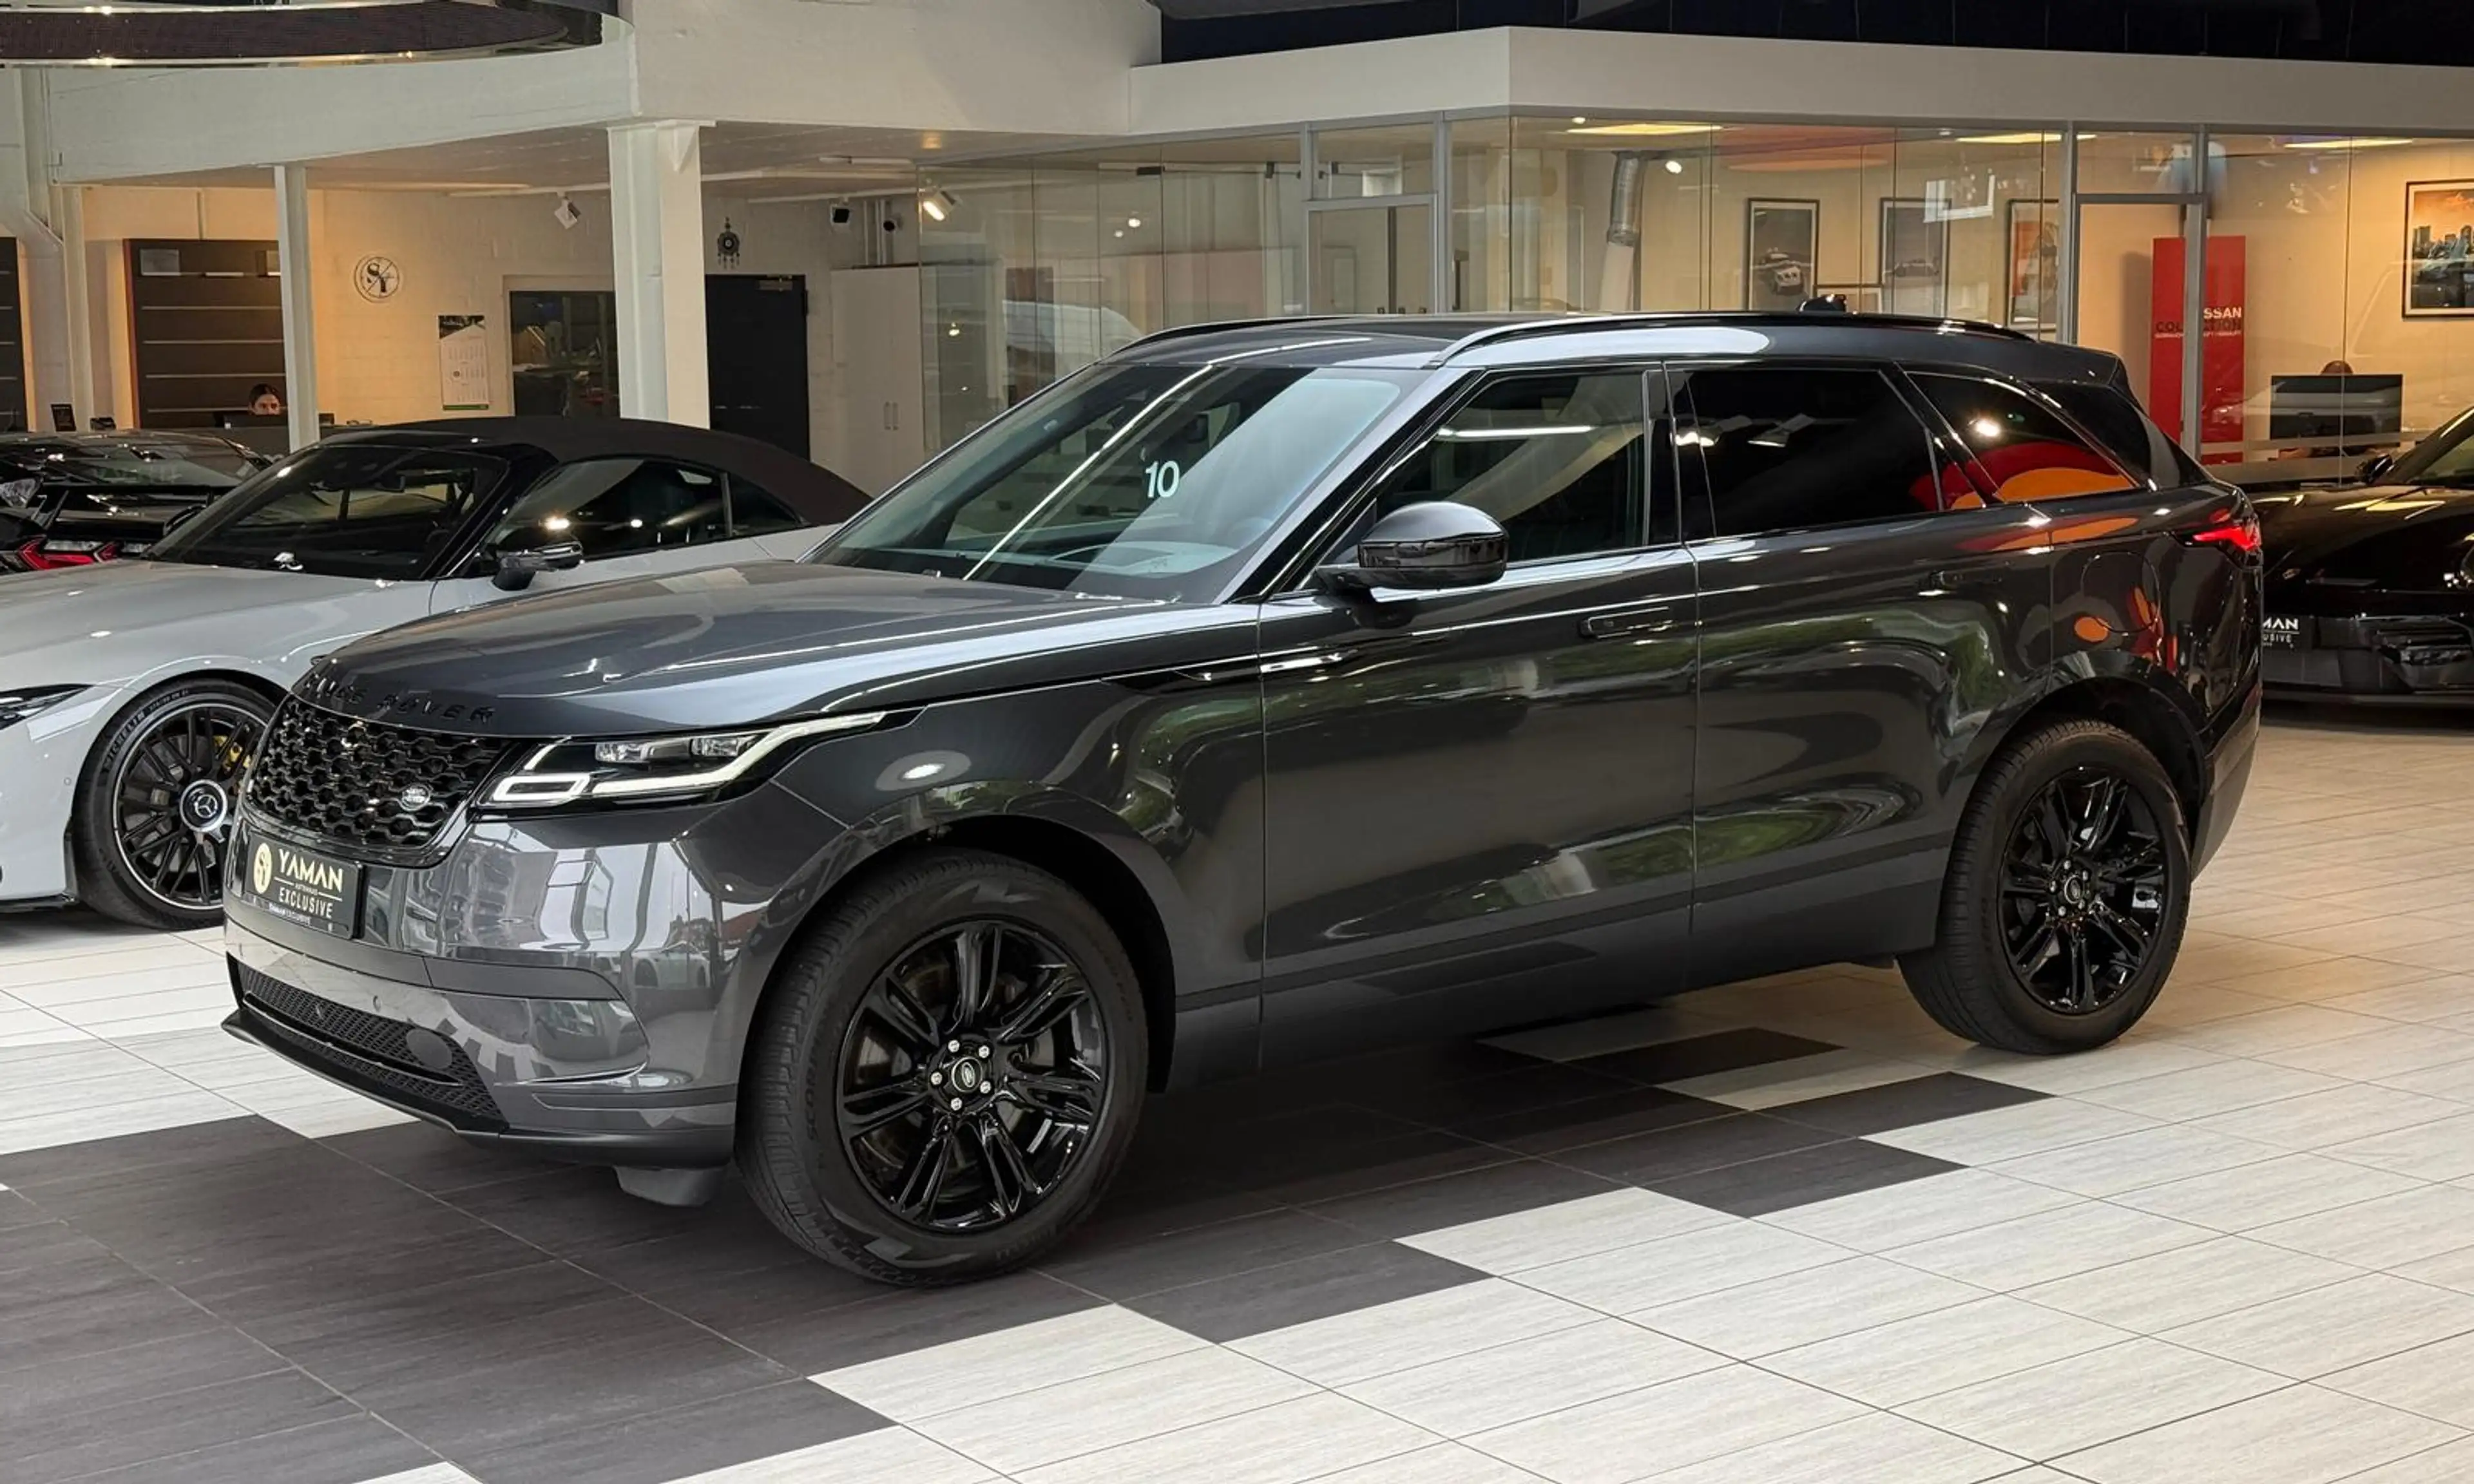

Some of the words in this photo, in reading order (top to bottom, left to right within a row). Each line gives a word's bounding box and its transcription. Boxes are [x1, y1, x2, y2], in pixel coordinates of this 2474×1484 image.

[2203, 307, 2241, 319] SSAN
[1146, 461, 1180, 498] 10
[2262, 616, 2299, 630] MAN
[2262, 633, 2292, 643] USIVE
[278, 848, 343, 893] YAMAN
[279, 887, 333, 919] EXCLUSIVE
